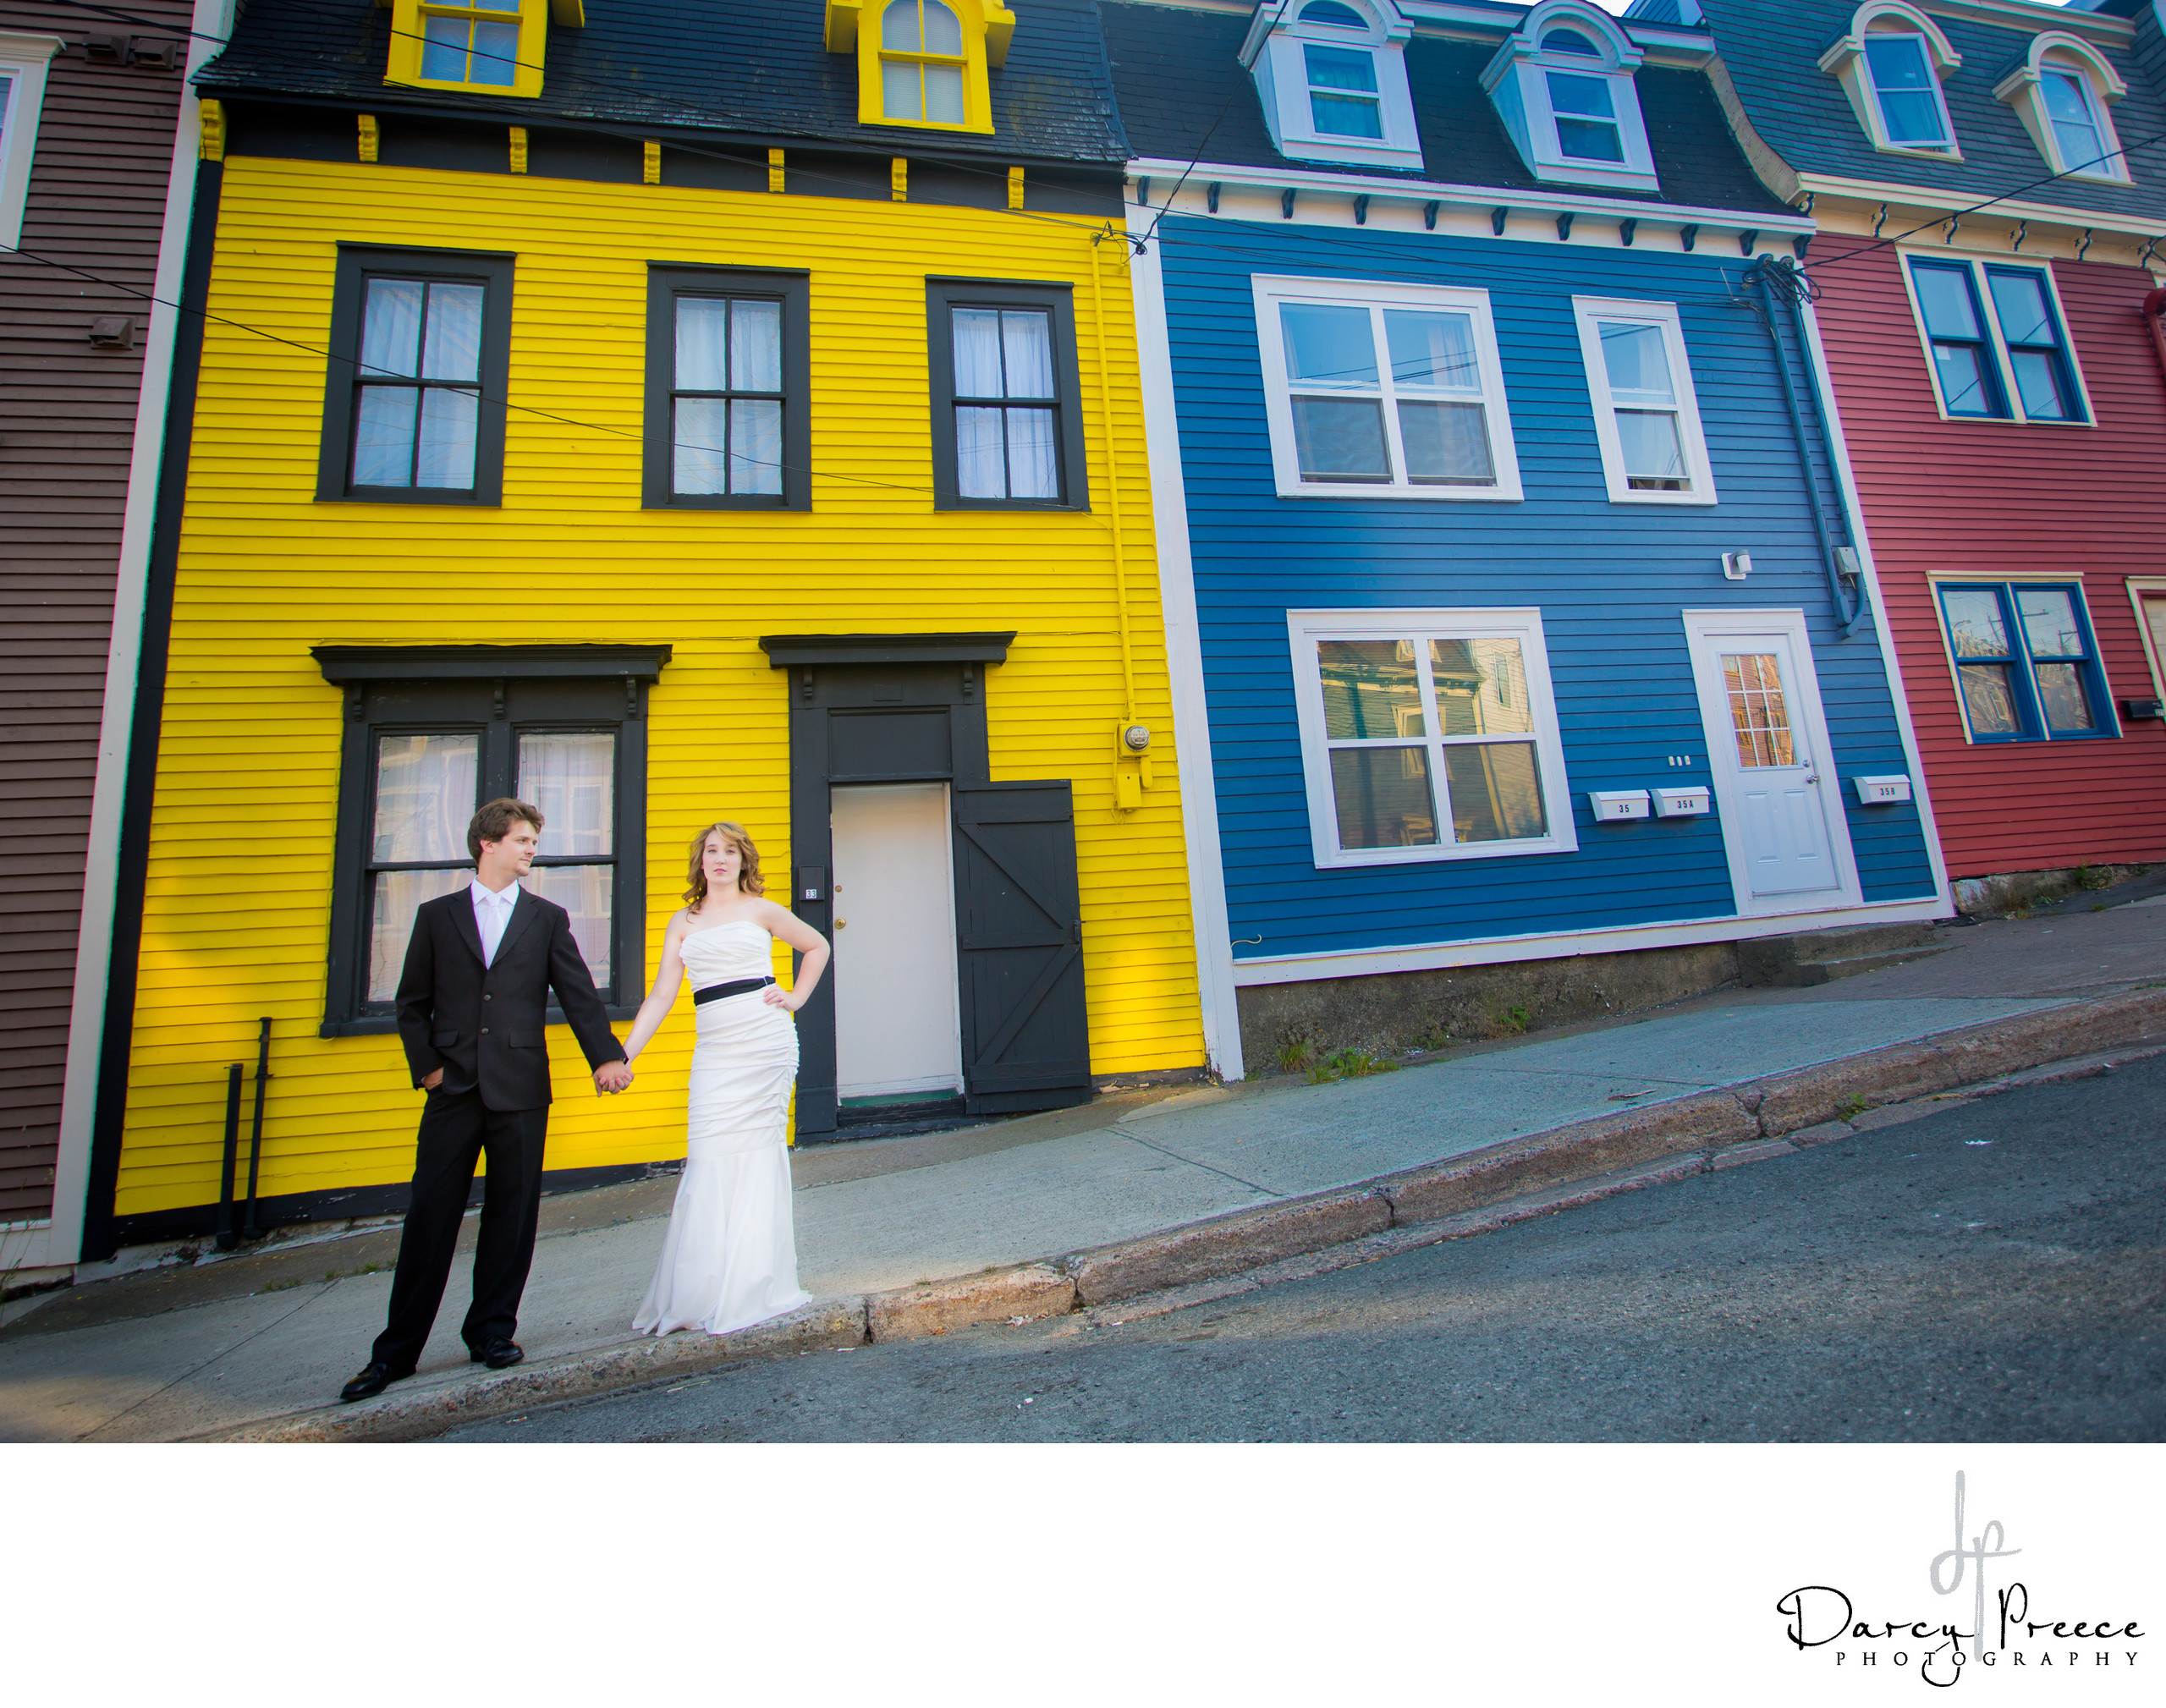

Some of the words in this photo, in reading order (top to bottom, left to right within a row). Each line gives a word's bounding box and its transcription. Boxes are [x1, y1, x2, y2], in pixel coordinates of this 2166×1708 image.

[1619, 805, 1630, 813] 35
[1677, 800, 1693, 809] 35A
[806, 889, 816, 898] 33
